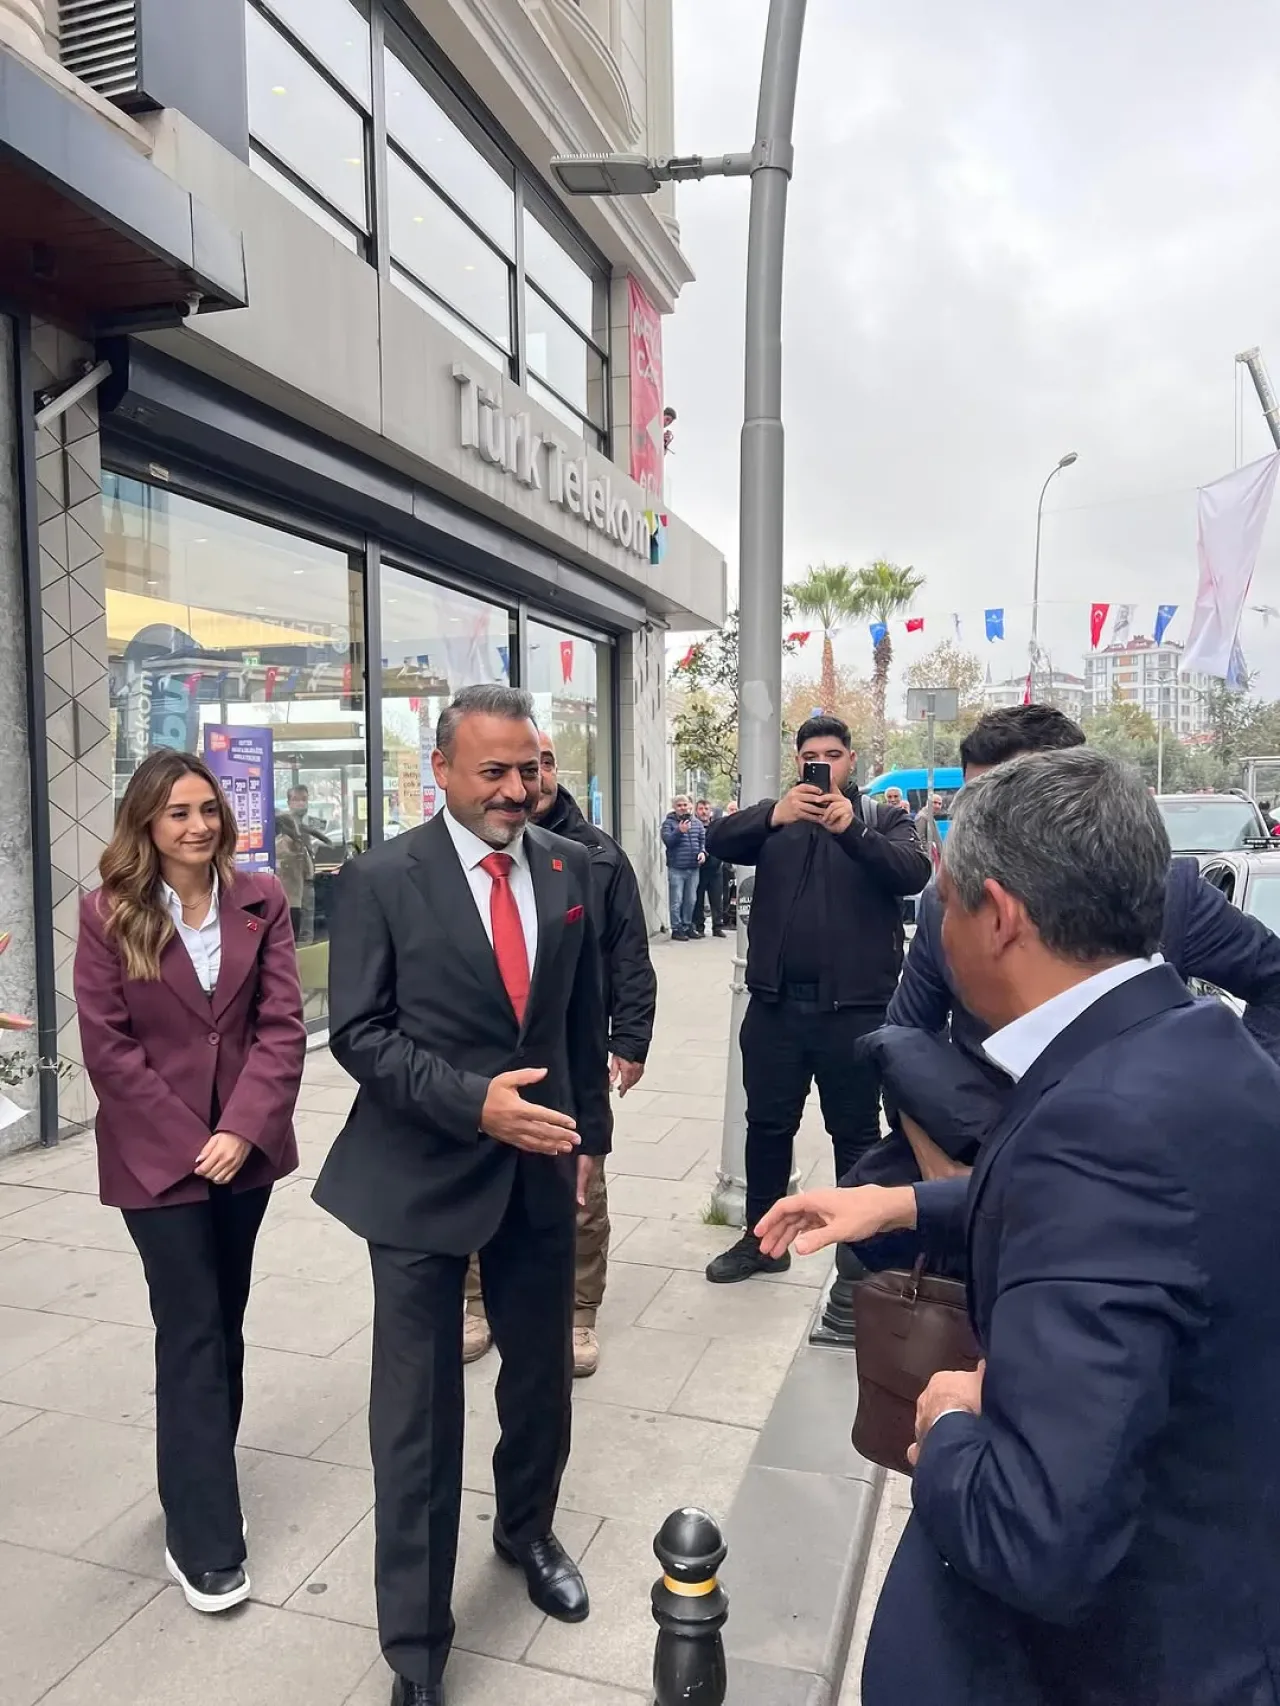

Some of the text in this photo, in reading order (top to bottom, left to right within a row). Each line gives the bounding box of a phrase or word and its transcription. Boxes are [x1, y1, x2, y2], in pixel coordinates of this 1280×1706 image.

[452, 361, 651, 560] Türk Telekom
[134, 671, 153, 771] elekom
